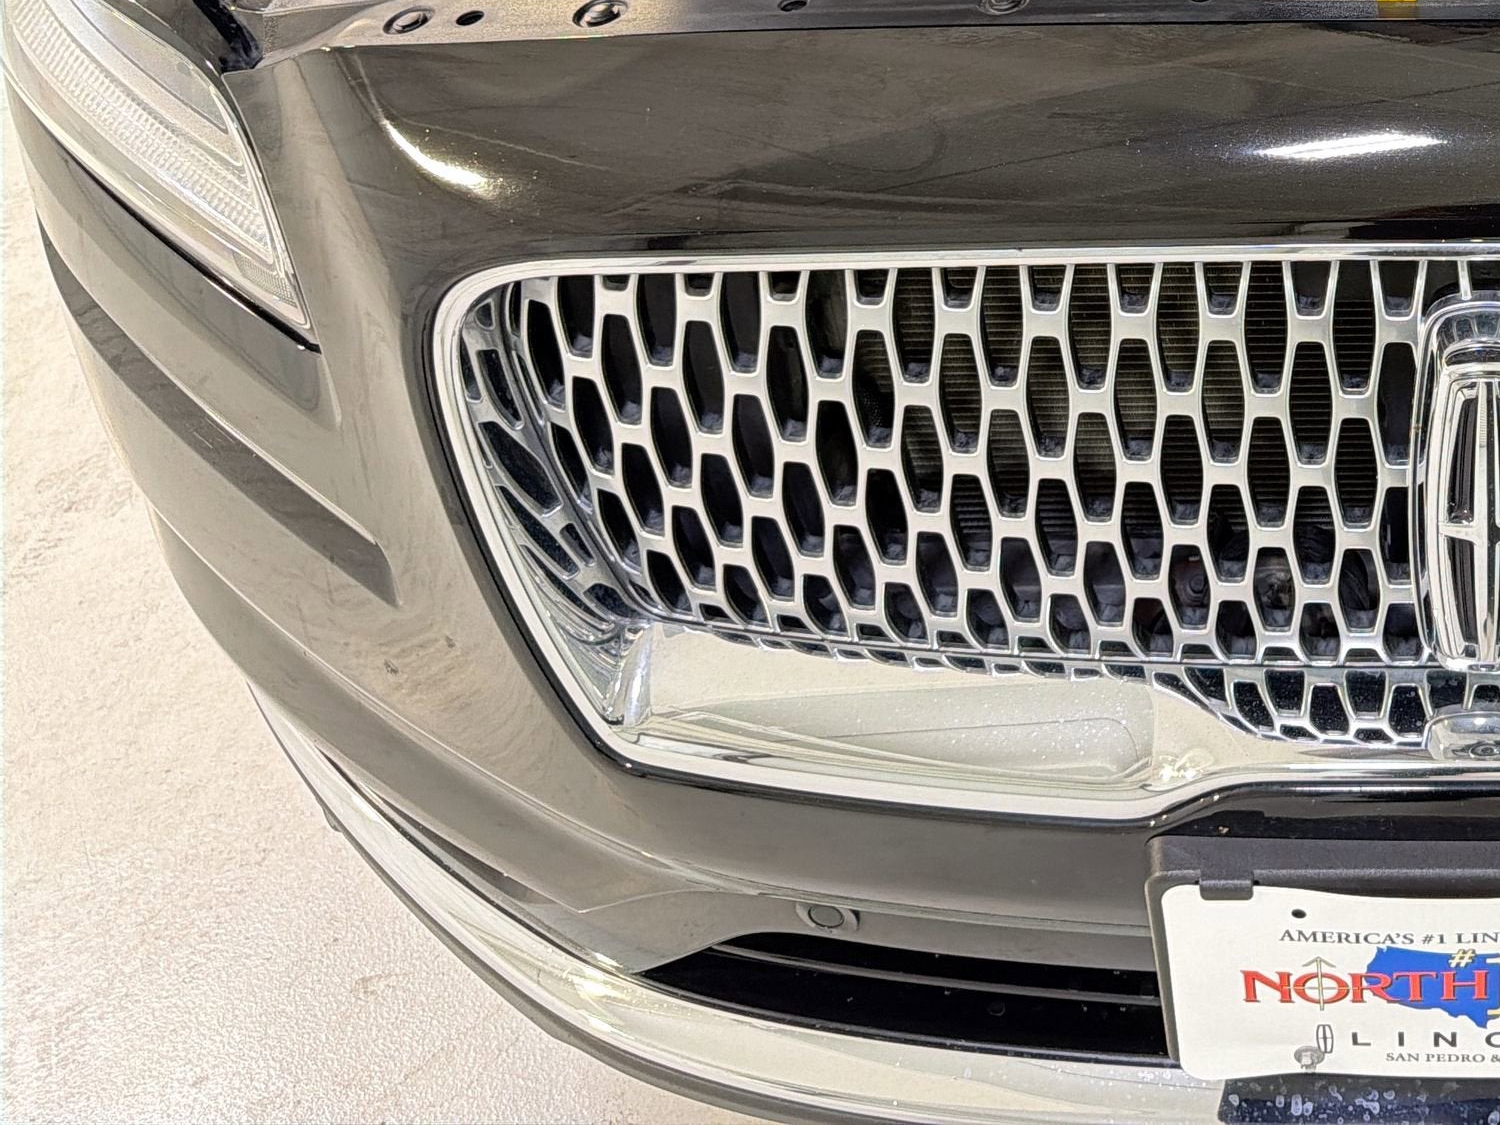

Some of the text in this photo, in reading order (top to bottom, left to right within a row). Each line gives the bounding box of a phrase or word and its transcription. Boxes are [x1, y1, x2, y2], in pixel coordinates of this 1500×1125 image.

[1279, 929, 1414, 944] AMERICA'S
[1422, 933, 1445, 944] #1
[1240, 969, 1489, 1004] NORTH
[1386, 1052, 1420, 1063] SAN
[1425, 1053, 1485, 1063] PEDRO
